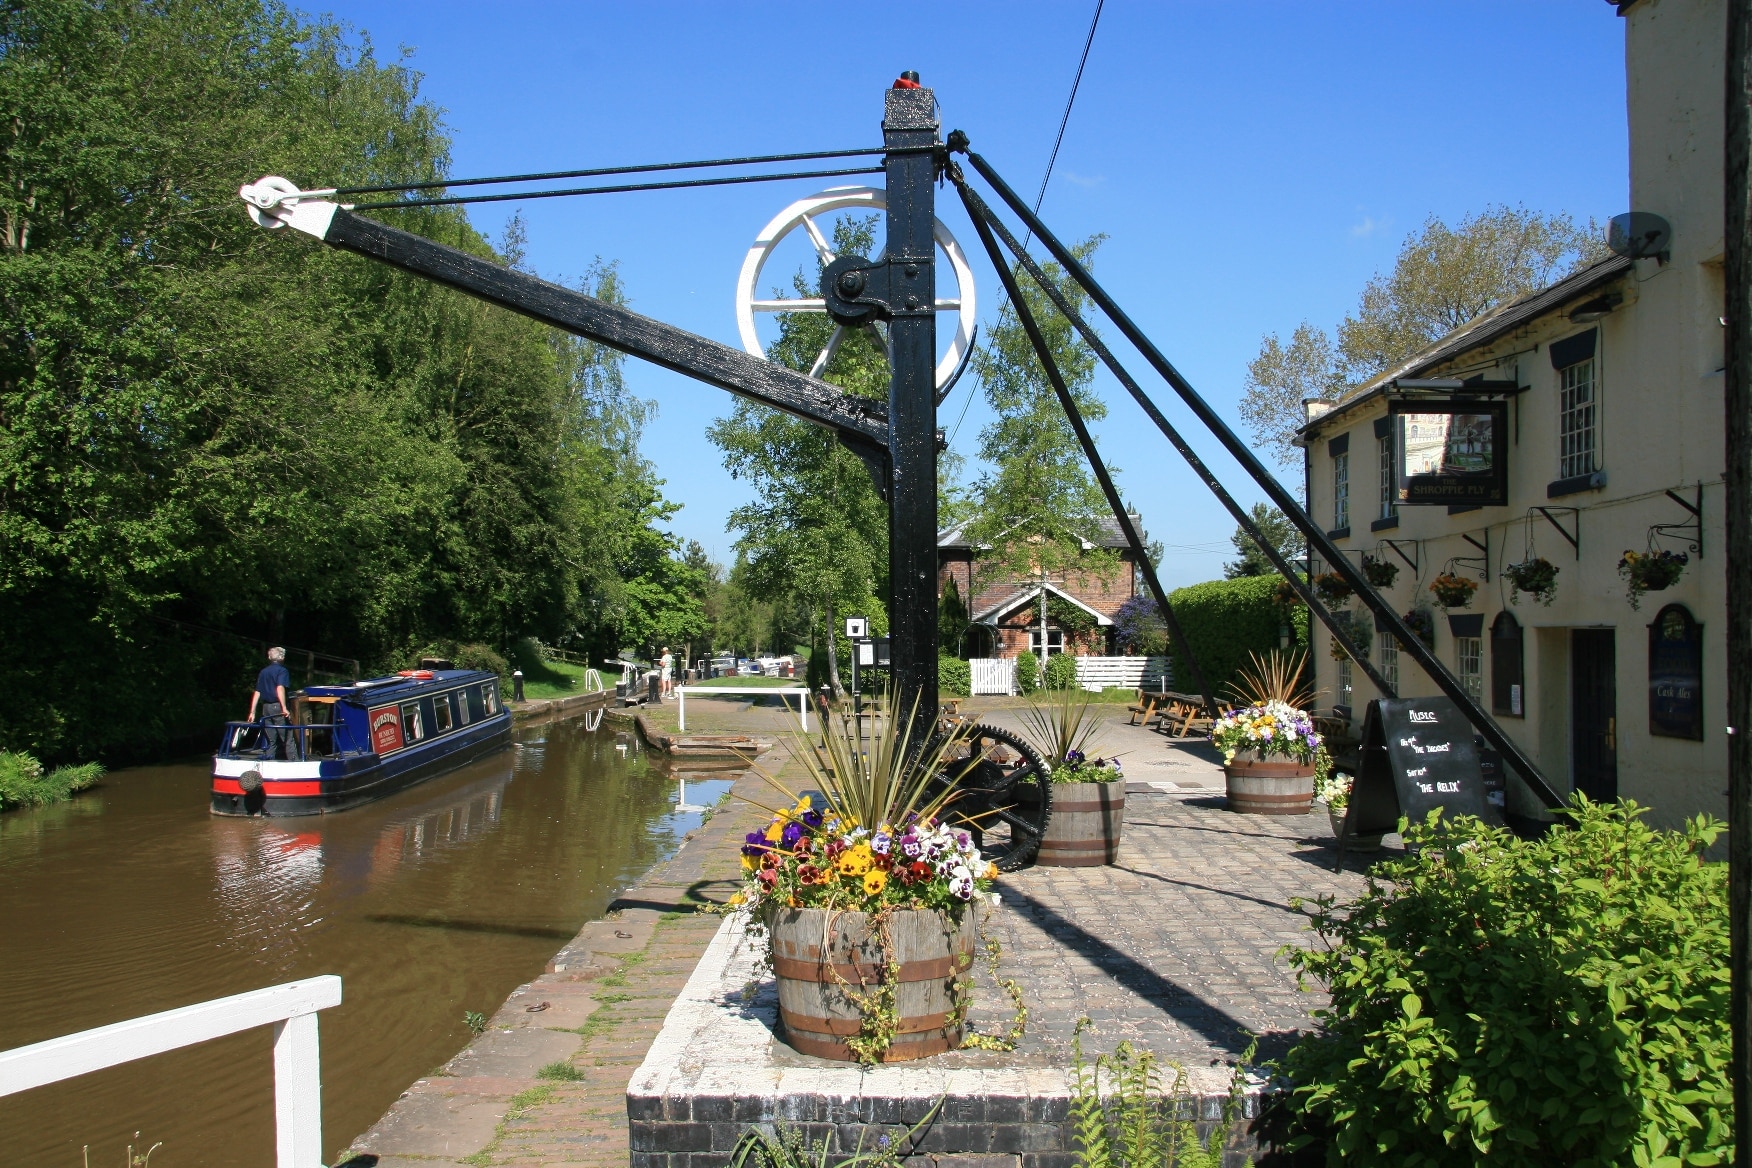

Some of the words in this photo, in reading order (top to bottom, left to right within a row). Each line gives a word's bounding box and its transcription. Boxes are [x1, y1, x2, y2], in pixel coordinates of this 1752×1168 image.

[1414, 485, 1465, 495] SHROPPIE
[1467, 485, 1486, 495] FLY
[1657, 685, 1674, 696] Cask
[1676, 687, 1691, 698] Ales
[374, 713, 397, 731] BURSTON
